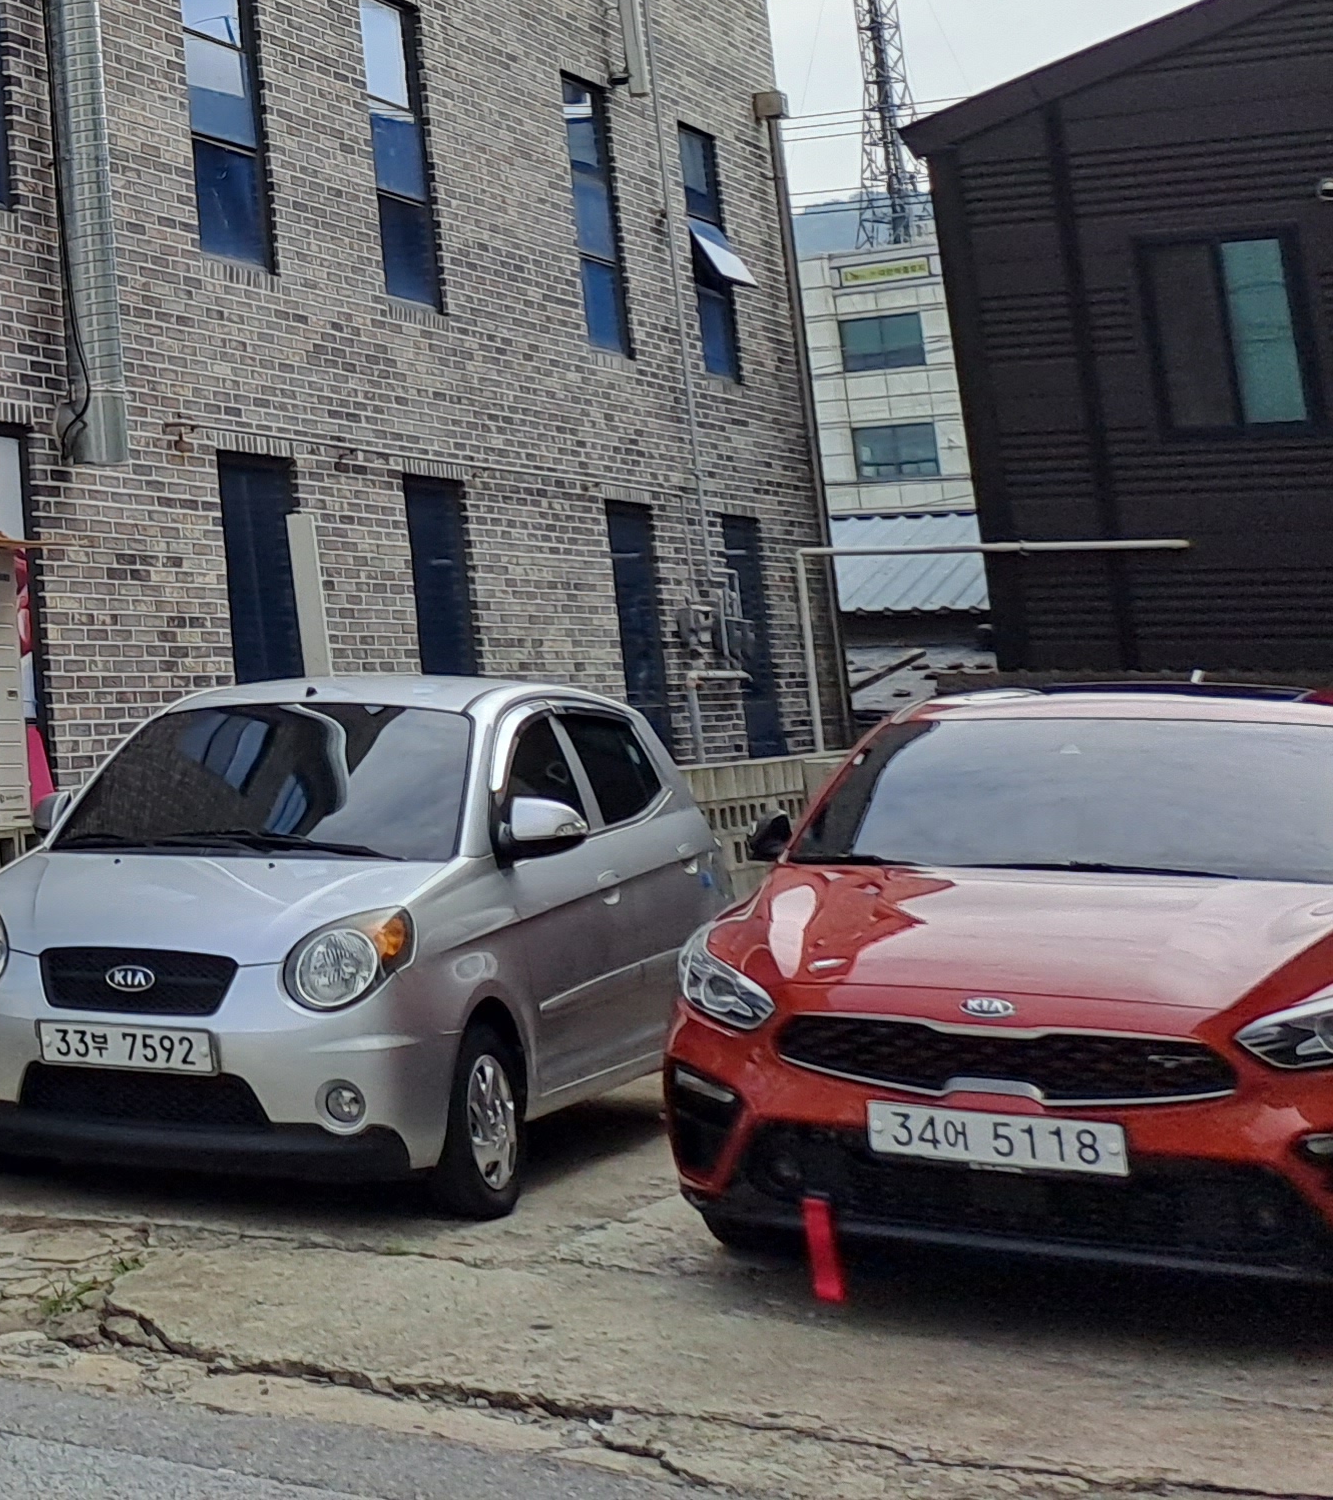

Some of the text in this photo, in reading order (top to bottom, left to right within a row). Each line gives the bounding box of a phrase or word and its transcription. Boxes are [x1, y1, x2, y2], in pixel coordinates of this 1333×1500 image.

[114, 970, 147, 987] KIA
[966, 999, 1005, 1014] KIA
[54, 1028, 197, 1066] 33부 7592
[890, 1111, 1101, 1165] 34어 5118
